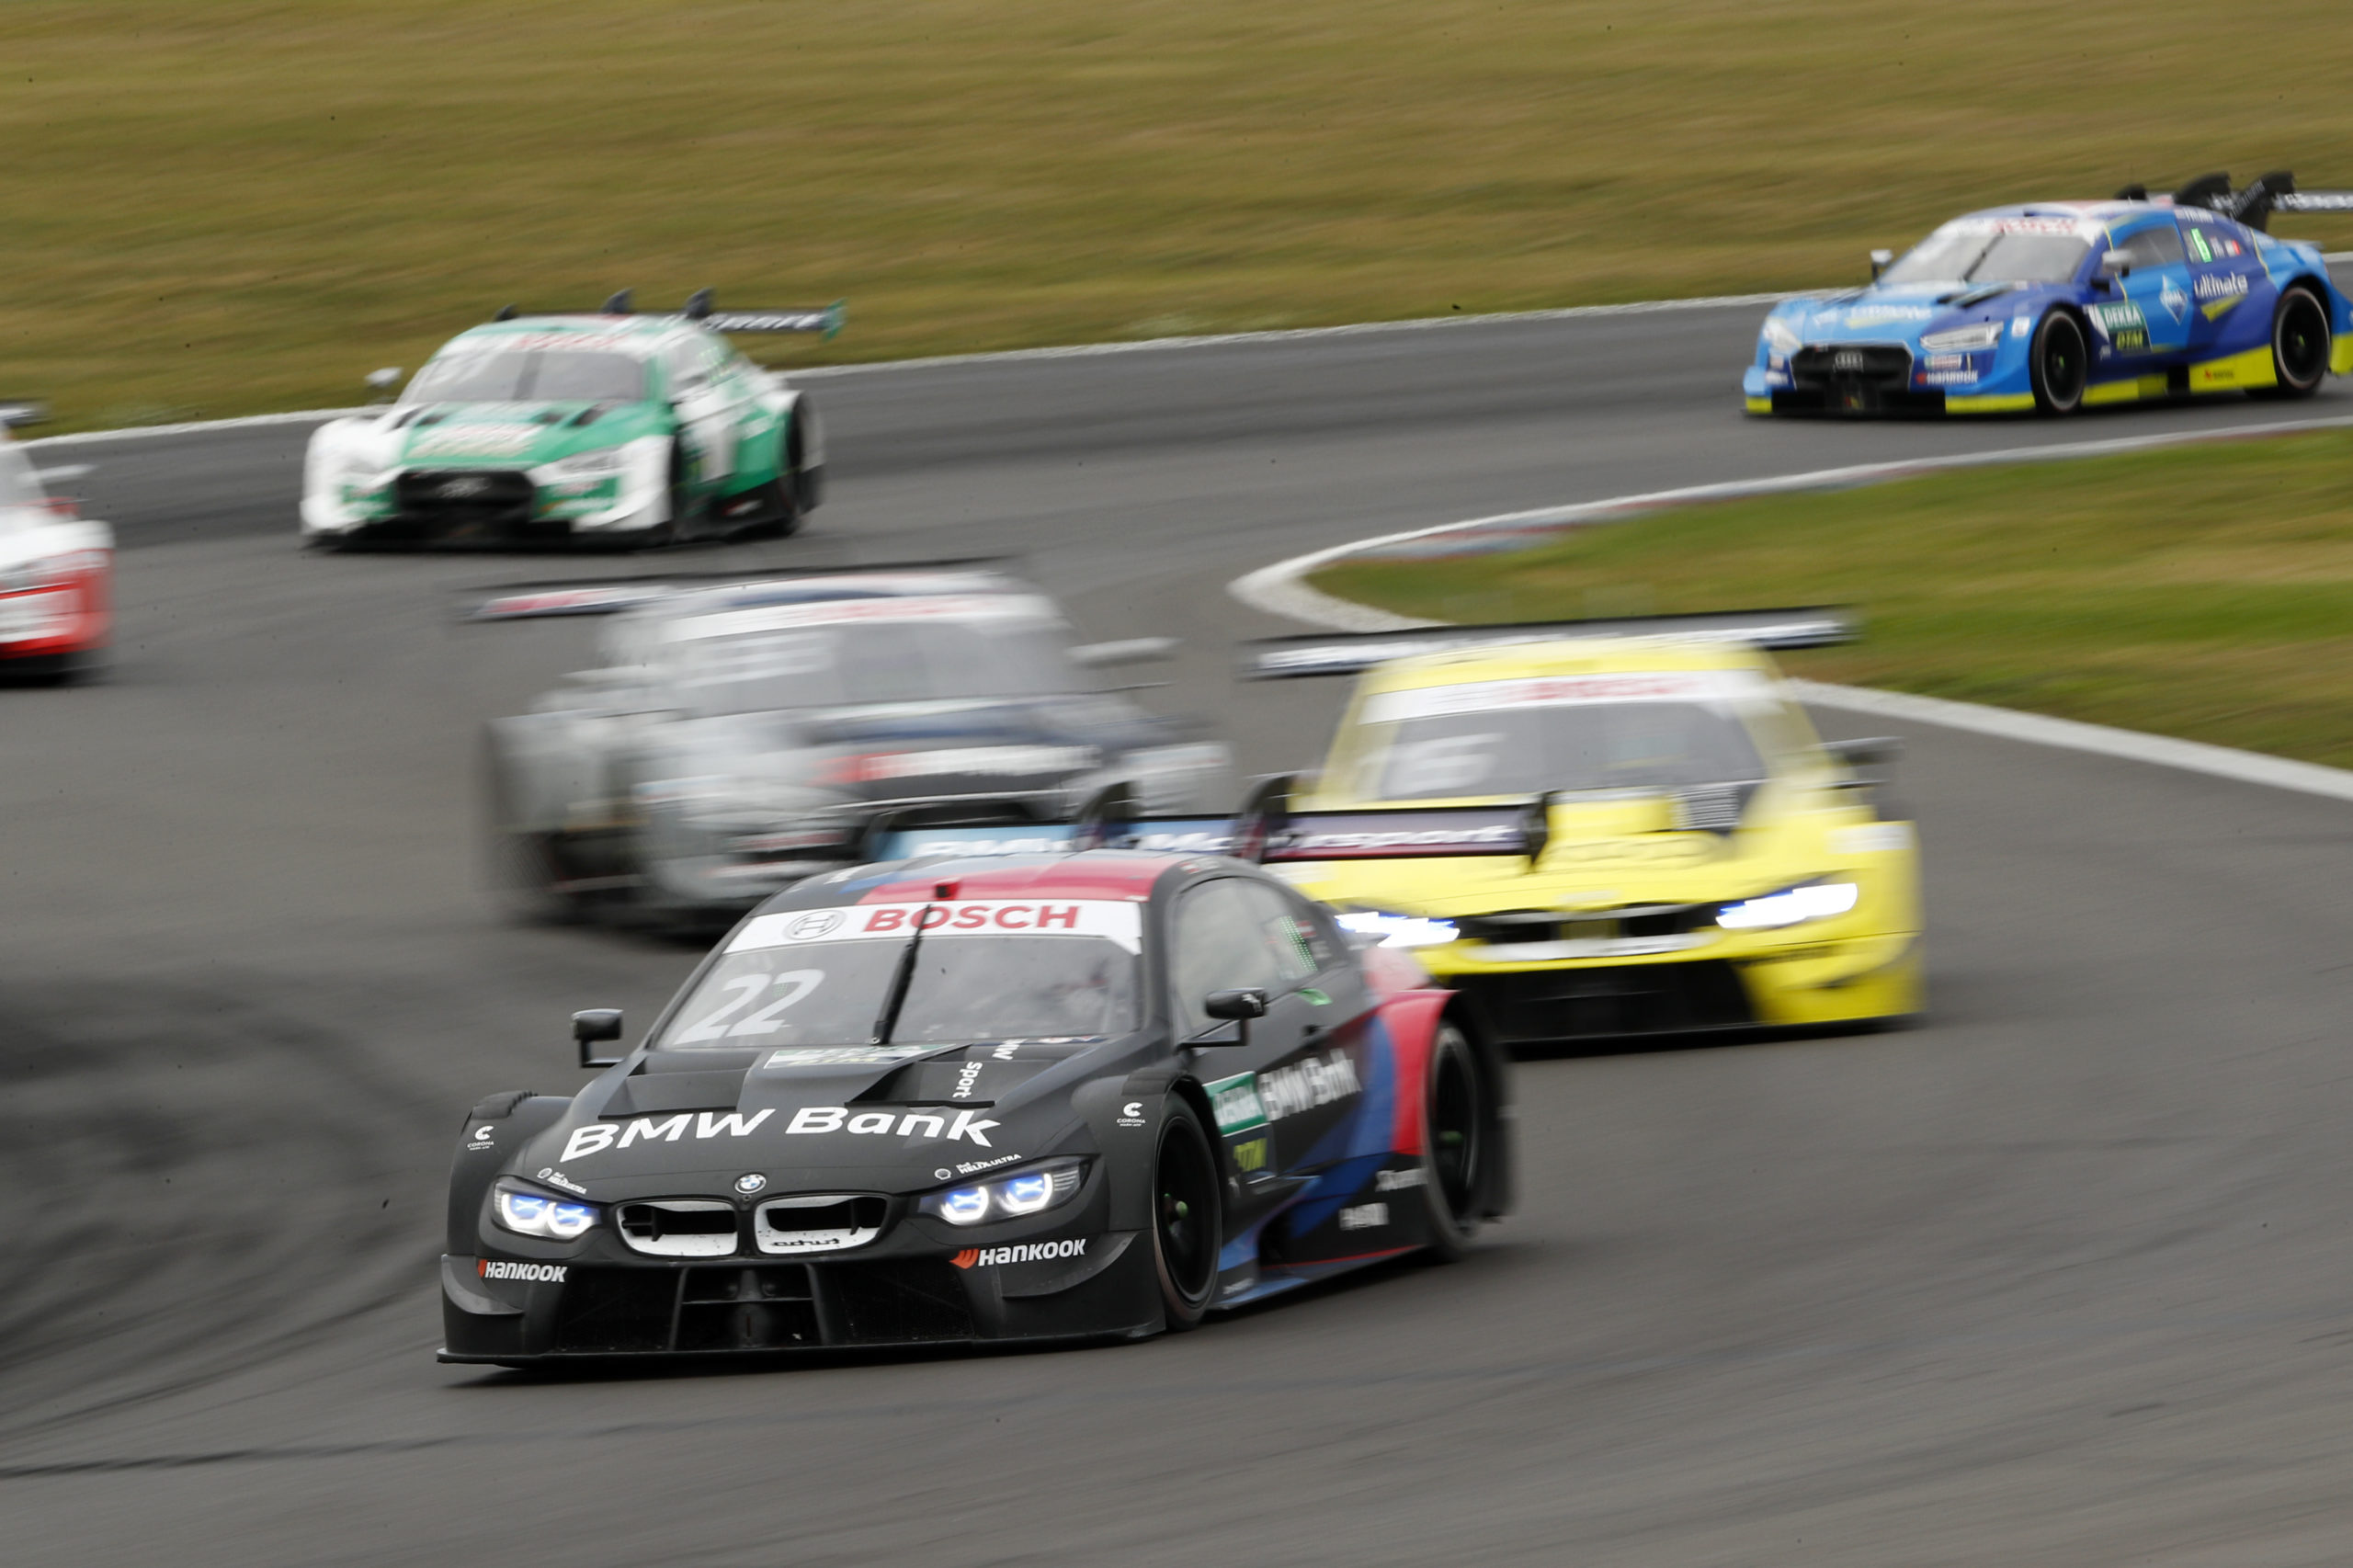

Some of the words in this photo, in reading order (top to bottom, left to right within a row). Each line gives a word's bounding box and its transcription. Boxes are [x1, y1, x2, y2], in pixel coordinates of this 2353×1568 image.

[863, 905, 1080, 932] BOSCH
[674, 968, 824, 1045] 22
[952, 1062, 983, 1098] sport
[560, 1108, 776, 1163] BMW
[785, 1107, 1001, 1148] Bank
